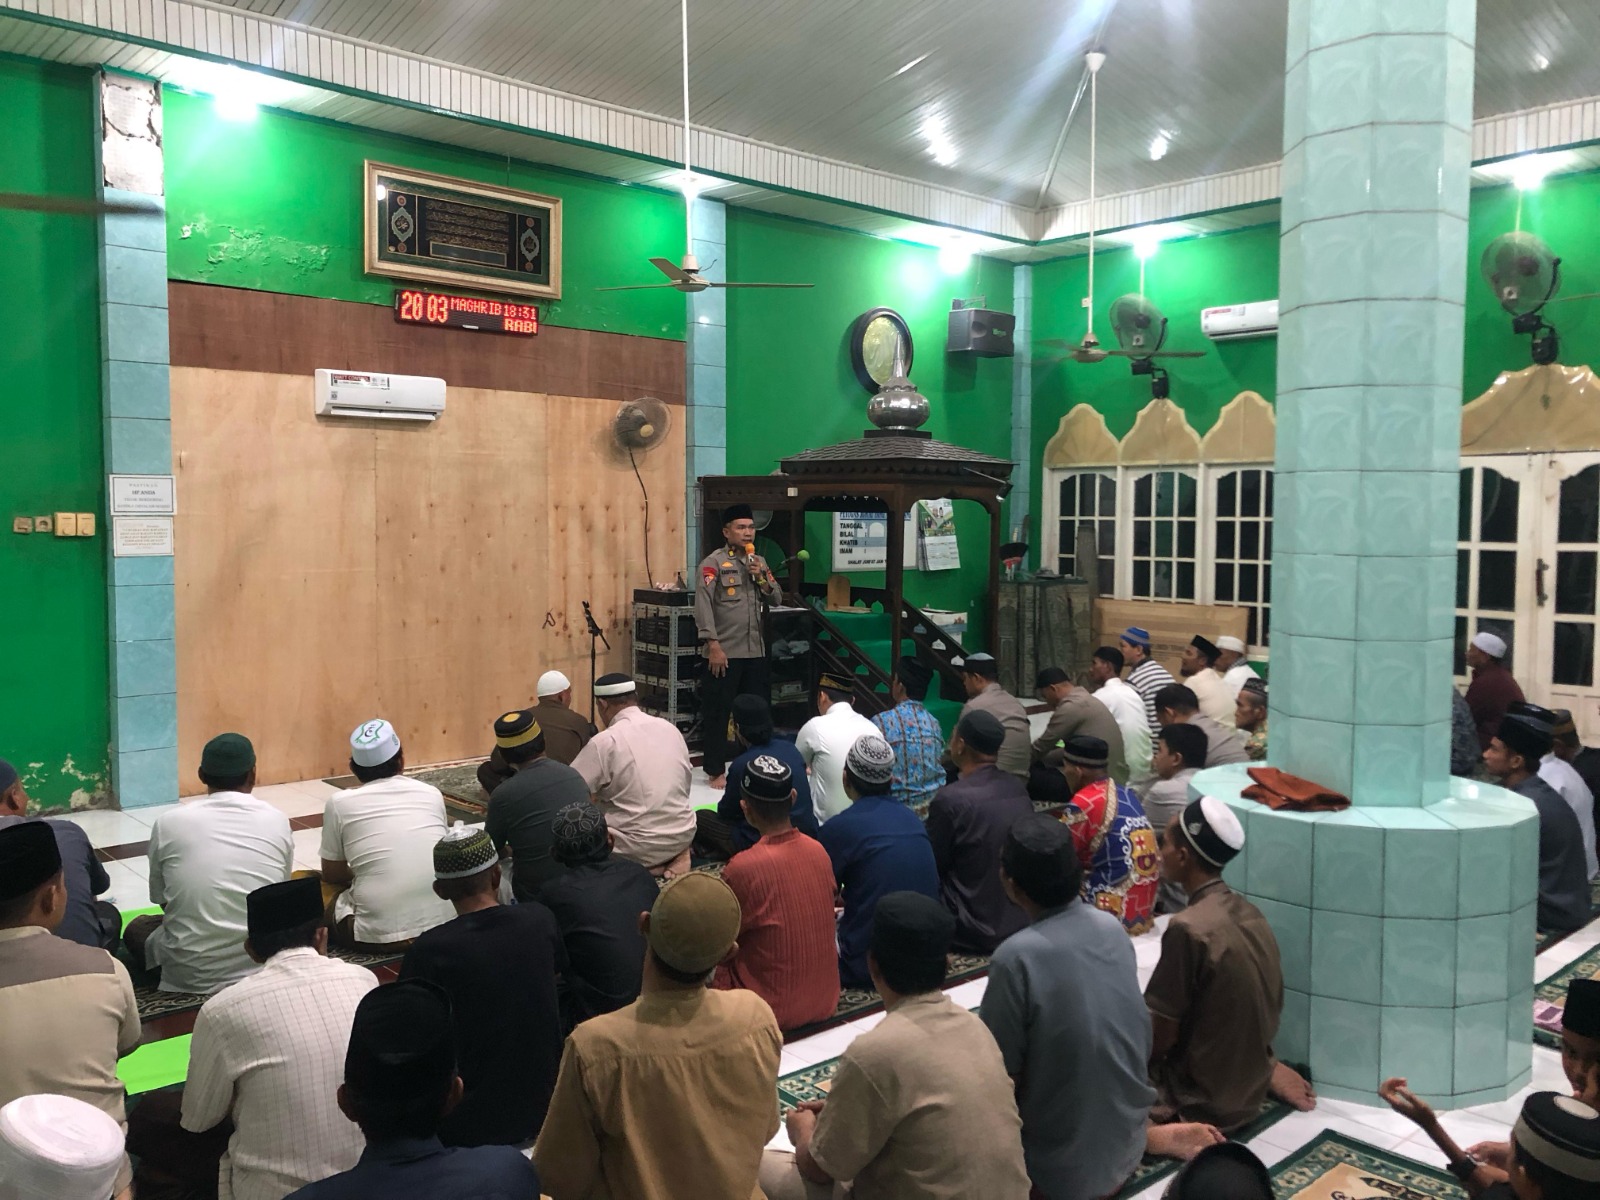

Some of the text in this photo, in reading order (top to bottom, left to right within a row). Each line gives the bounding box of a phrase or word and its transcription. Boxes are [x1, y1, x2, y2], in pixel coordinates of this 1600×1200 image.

[401, 291, 448, 323] 20 03
[450, 297, 537, 320] MAGHRIB 18:31
